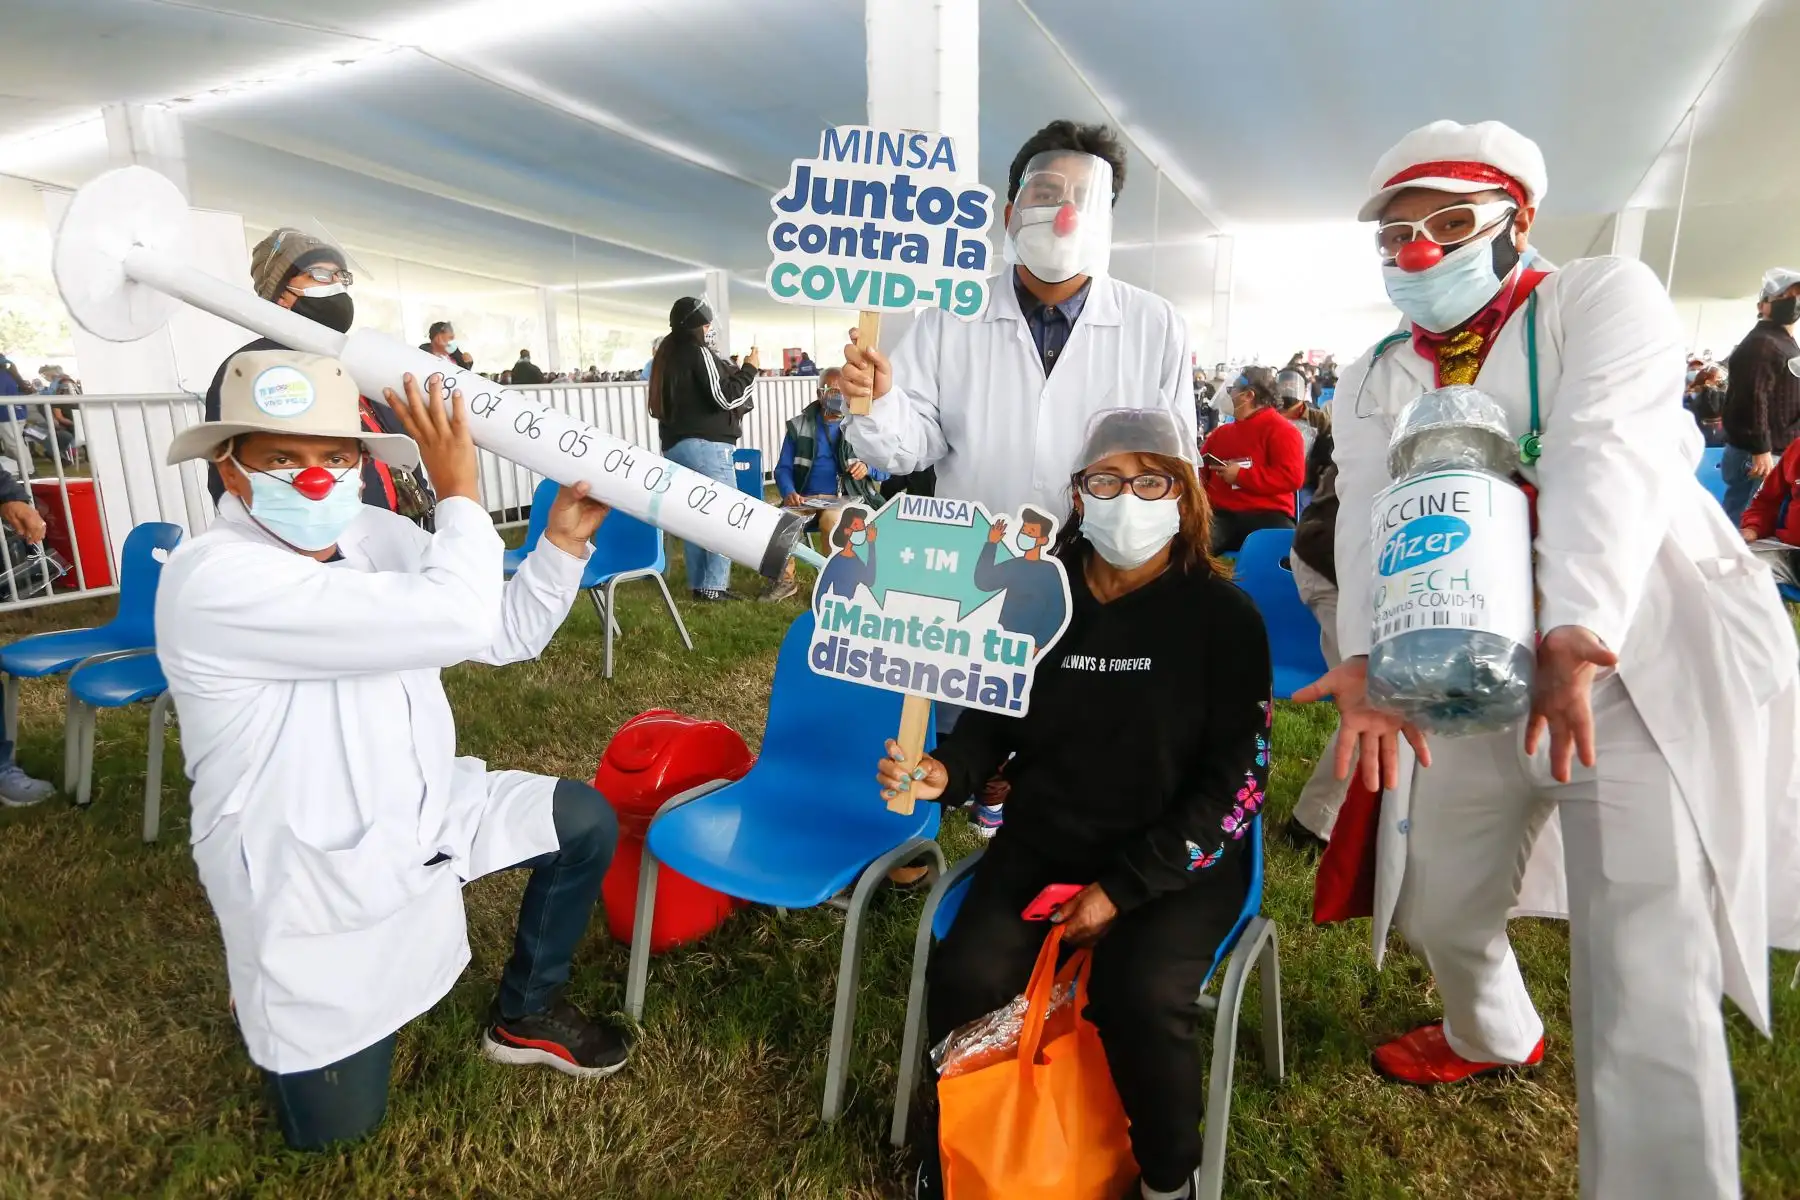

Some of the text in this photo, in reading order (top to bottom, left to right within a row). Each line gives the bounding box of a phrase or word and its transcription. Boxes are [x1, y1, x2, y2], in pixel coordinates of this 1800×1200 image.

[822, 128, 956, 172] MINSA
[776, 166, 989, 229] Juntos
[773, 222, 987, 270] contra la
[771, 262, 983, 316] COVID-19
[903, 496, 969, 522] MINSA
[924, 547, 959, 573] 1M
[1418, 593, 1485, 610] COVID-19
[821, 600, 1028, 668] ¡Mantén tu
[812, 636, 1027, 711] distancia!
[1061, 654, 1152, 672] ALWAYS & FOREVER
